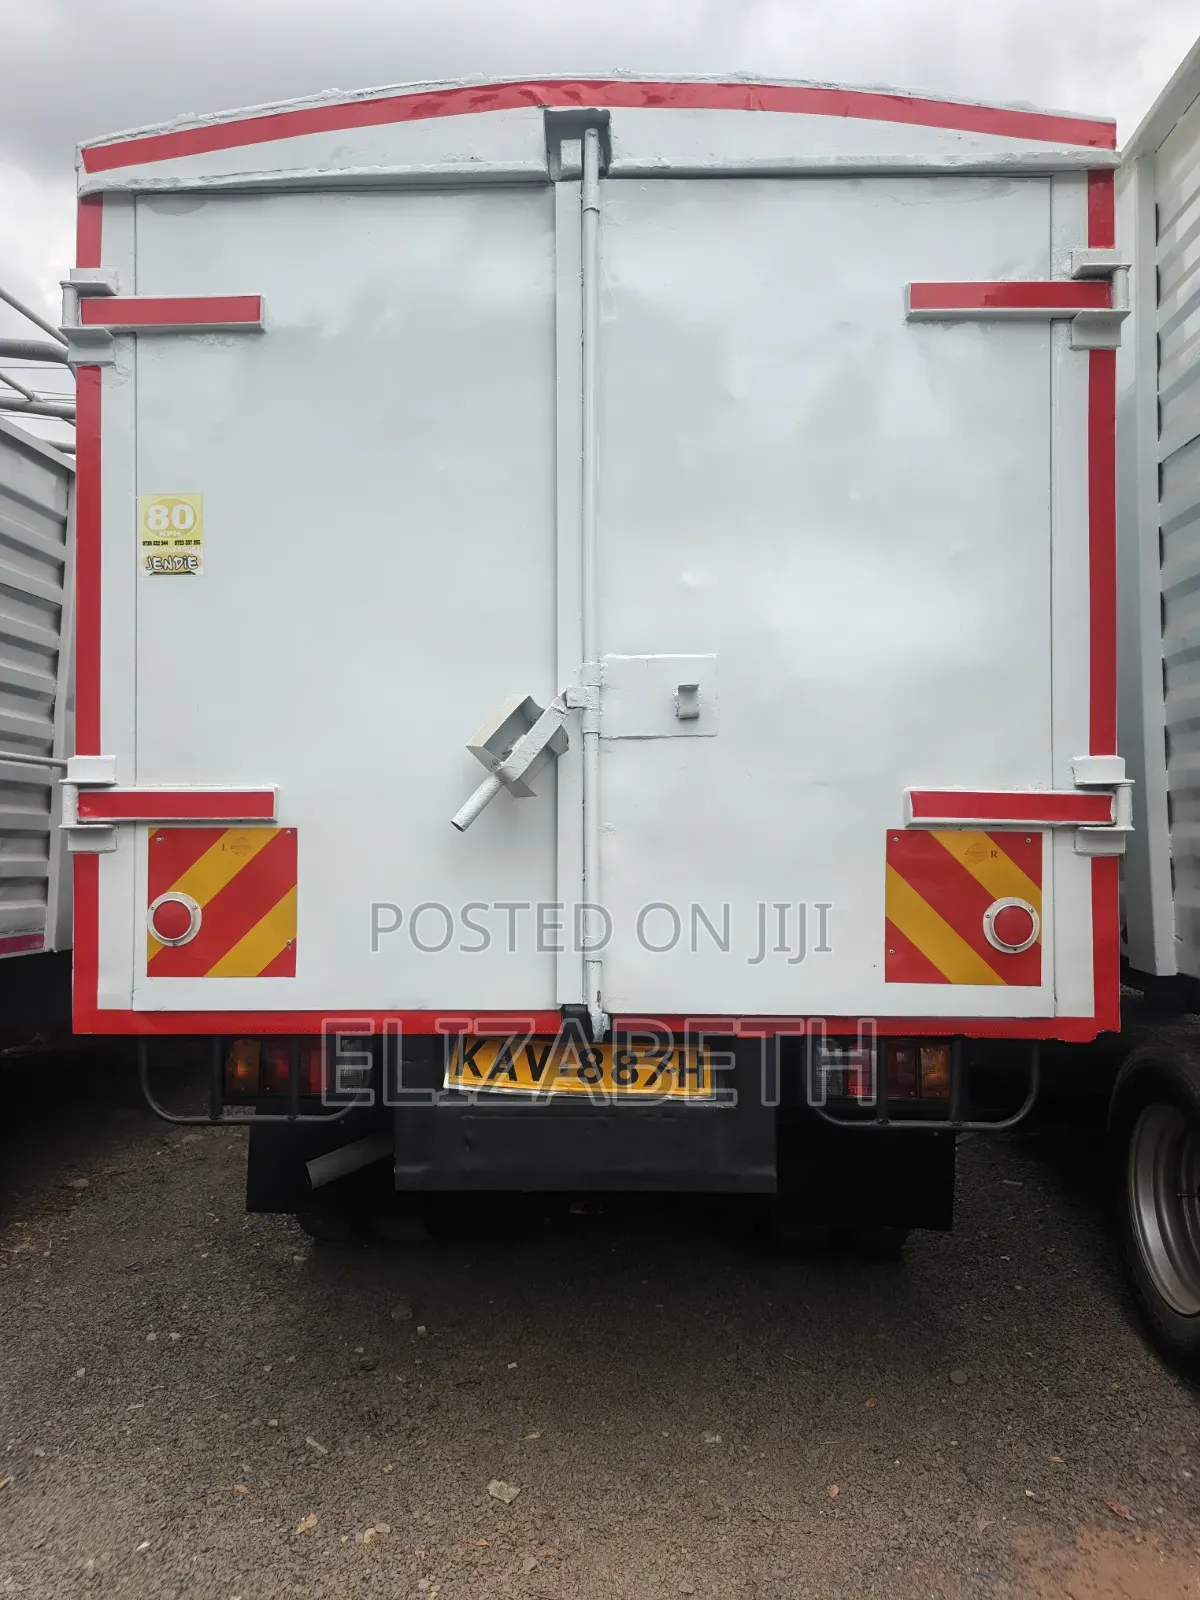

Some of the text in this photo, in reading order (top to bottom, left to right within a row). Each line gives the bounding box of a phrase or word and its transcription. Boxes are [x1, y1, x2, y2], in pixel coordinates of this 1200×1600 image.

[148, 504, 194, 530] 80
[990, 850, 998, 858] R
[455, 1038, 706, 1089] KAV 887H
